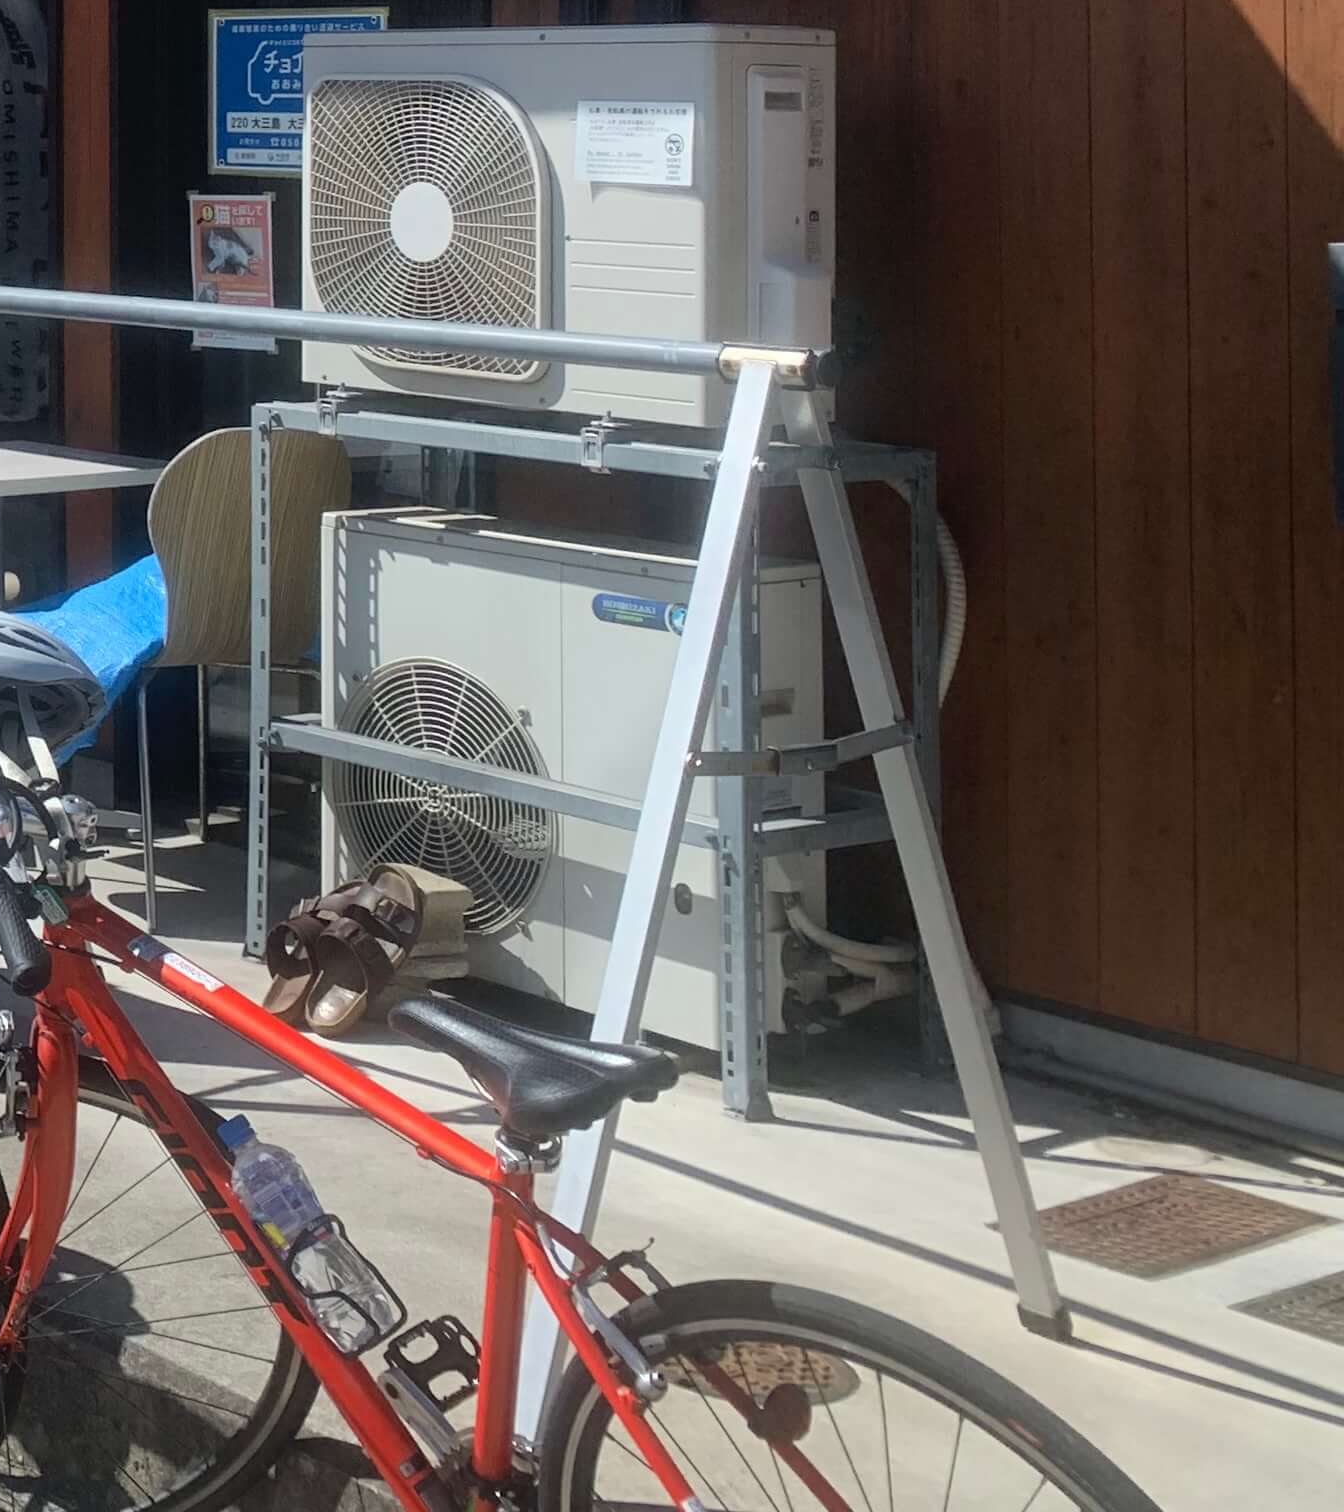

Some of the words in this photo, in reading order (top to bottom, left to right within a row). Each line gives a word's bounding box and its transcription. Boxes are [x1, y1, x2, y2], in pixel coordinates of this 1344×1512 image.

[231, 118, 249, 129] 220
[251, 117, 281, 130] 大三島
[118, 1078, 312, 1328] GIANT
